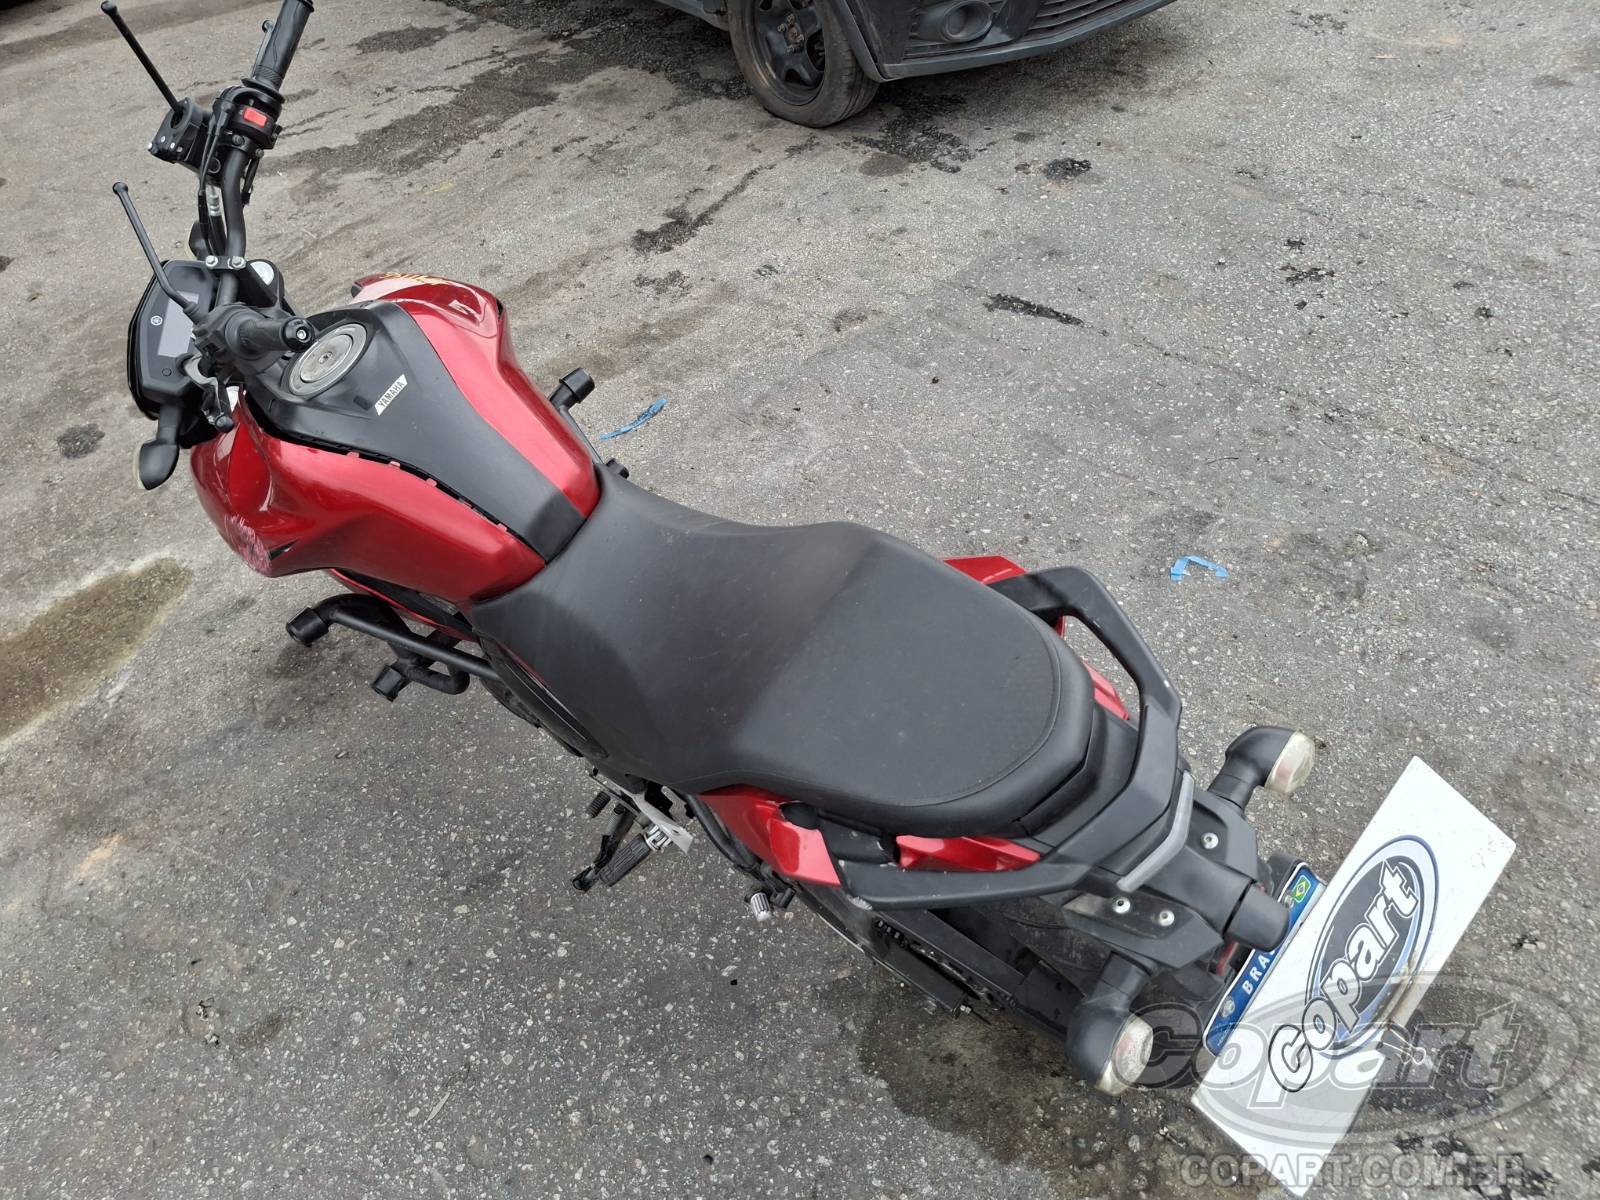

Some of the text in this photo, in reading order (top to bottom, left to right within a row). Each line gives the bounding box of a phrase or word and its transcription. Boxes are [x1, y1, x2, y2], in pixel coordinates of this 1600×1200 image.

[377, 380, 405, 408] YAMAHA
[1241, 949, 1276, 996] BRA
[1268, 861, 1419, 1093] Copart
